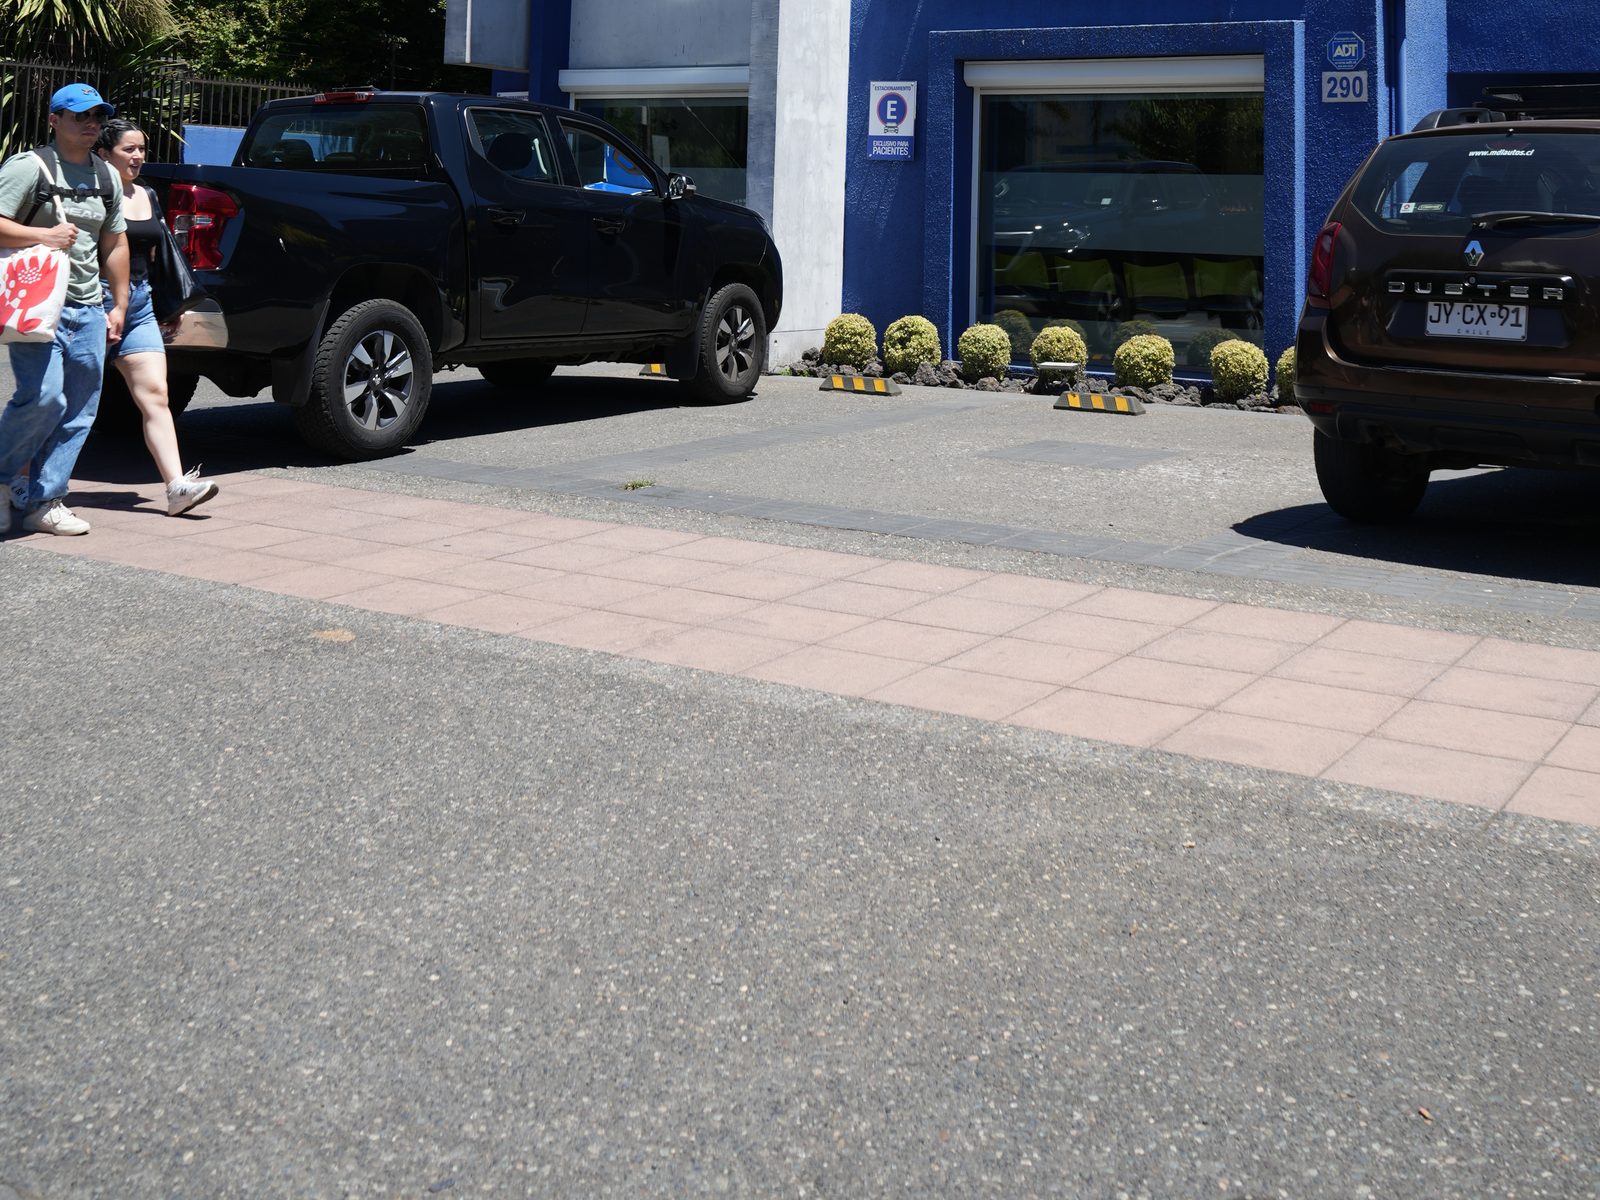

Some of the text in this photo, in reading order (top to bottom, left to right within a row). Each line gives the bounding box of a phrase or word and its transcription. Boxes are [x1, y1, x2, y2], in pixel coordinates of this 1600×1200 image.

[1333, 44, 1358, 57] ADT
[1327, 77, 1364, 98] 290
[887, 101, 897, 119] E
[873, 147, 908, 155] PACIENTES
[1387, 281, 1564, 300] DUSTER
